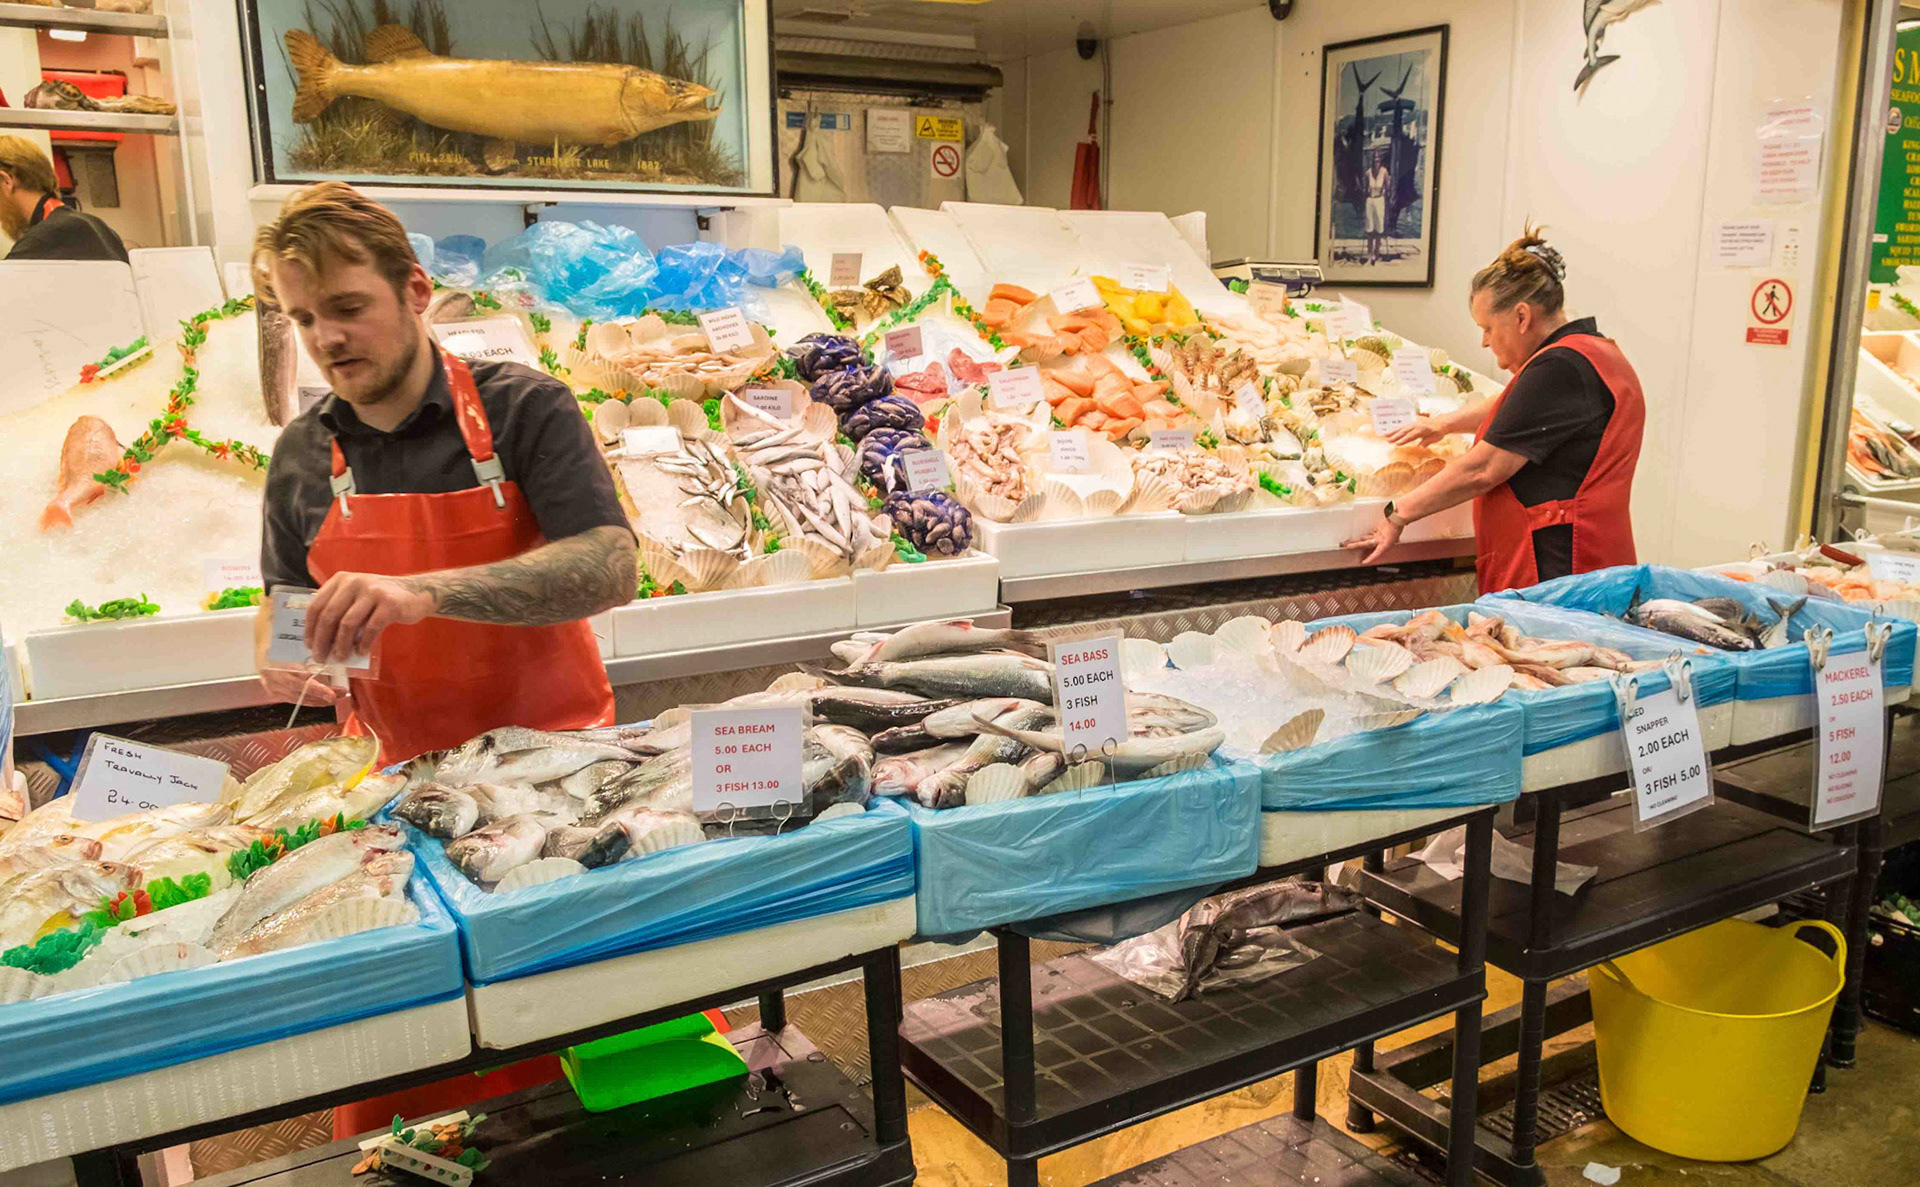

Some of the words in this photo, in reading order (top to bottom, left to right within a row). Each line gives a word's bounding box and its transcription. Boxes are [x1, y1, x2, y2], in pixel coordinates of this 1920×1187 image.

[587, 159, 609, 169] LAKE
[638, 161, 661, 171] 1882
[483, 347, 514, 357] EACH
[1061, 654, 1081, 666] SEA
[1083, 648, 1109, 662] BASS
[1063, 675, 1085, 688] 5.00
[1086, 670, 1114, 684] EACH
[1824, 666, 1871, 683] MACKEREL
[1066, 699, 1073, 710] 3
[1075, 695, 1098, 708] FISH
[1831, 692, 1850, 707] 2.50
[1850, 689, 1874, 704] EACH
[714, 727, 736, 736] SEA
[737, 725, 775, 735] BREAM
[1069, 718, 1096, 731] 14.00
[1636, 716, 1669, 735] SNAPPER
[1829, 731, 1835, 742] 5
[1836, 727, 1855, 741] FISH
[104, 742, 142, 760] FRESH
[714, 745, 737, 755] 5.00
[741, 743, 772, 753] EACH
[1638, 740, 1660, 758] 2.00
[1661, 729, 1690, 750] EACH
[1829, 750, 1851, 765] 12.00
[715, 764, 732, 774] OR
[715, 784, 723, 793] 3
[724, 781, 749, 792] FISH
[751, 780, 780, 790] 13.00
[1645, 783, 1652, 796] 3
[1653, 773, 1677, 793] FISH
[1680, 764, 1701, 782] 5.00
